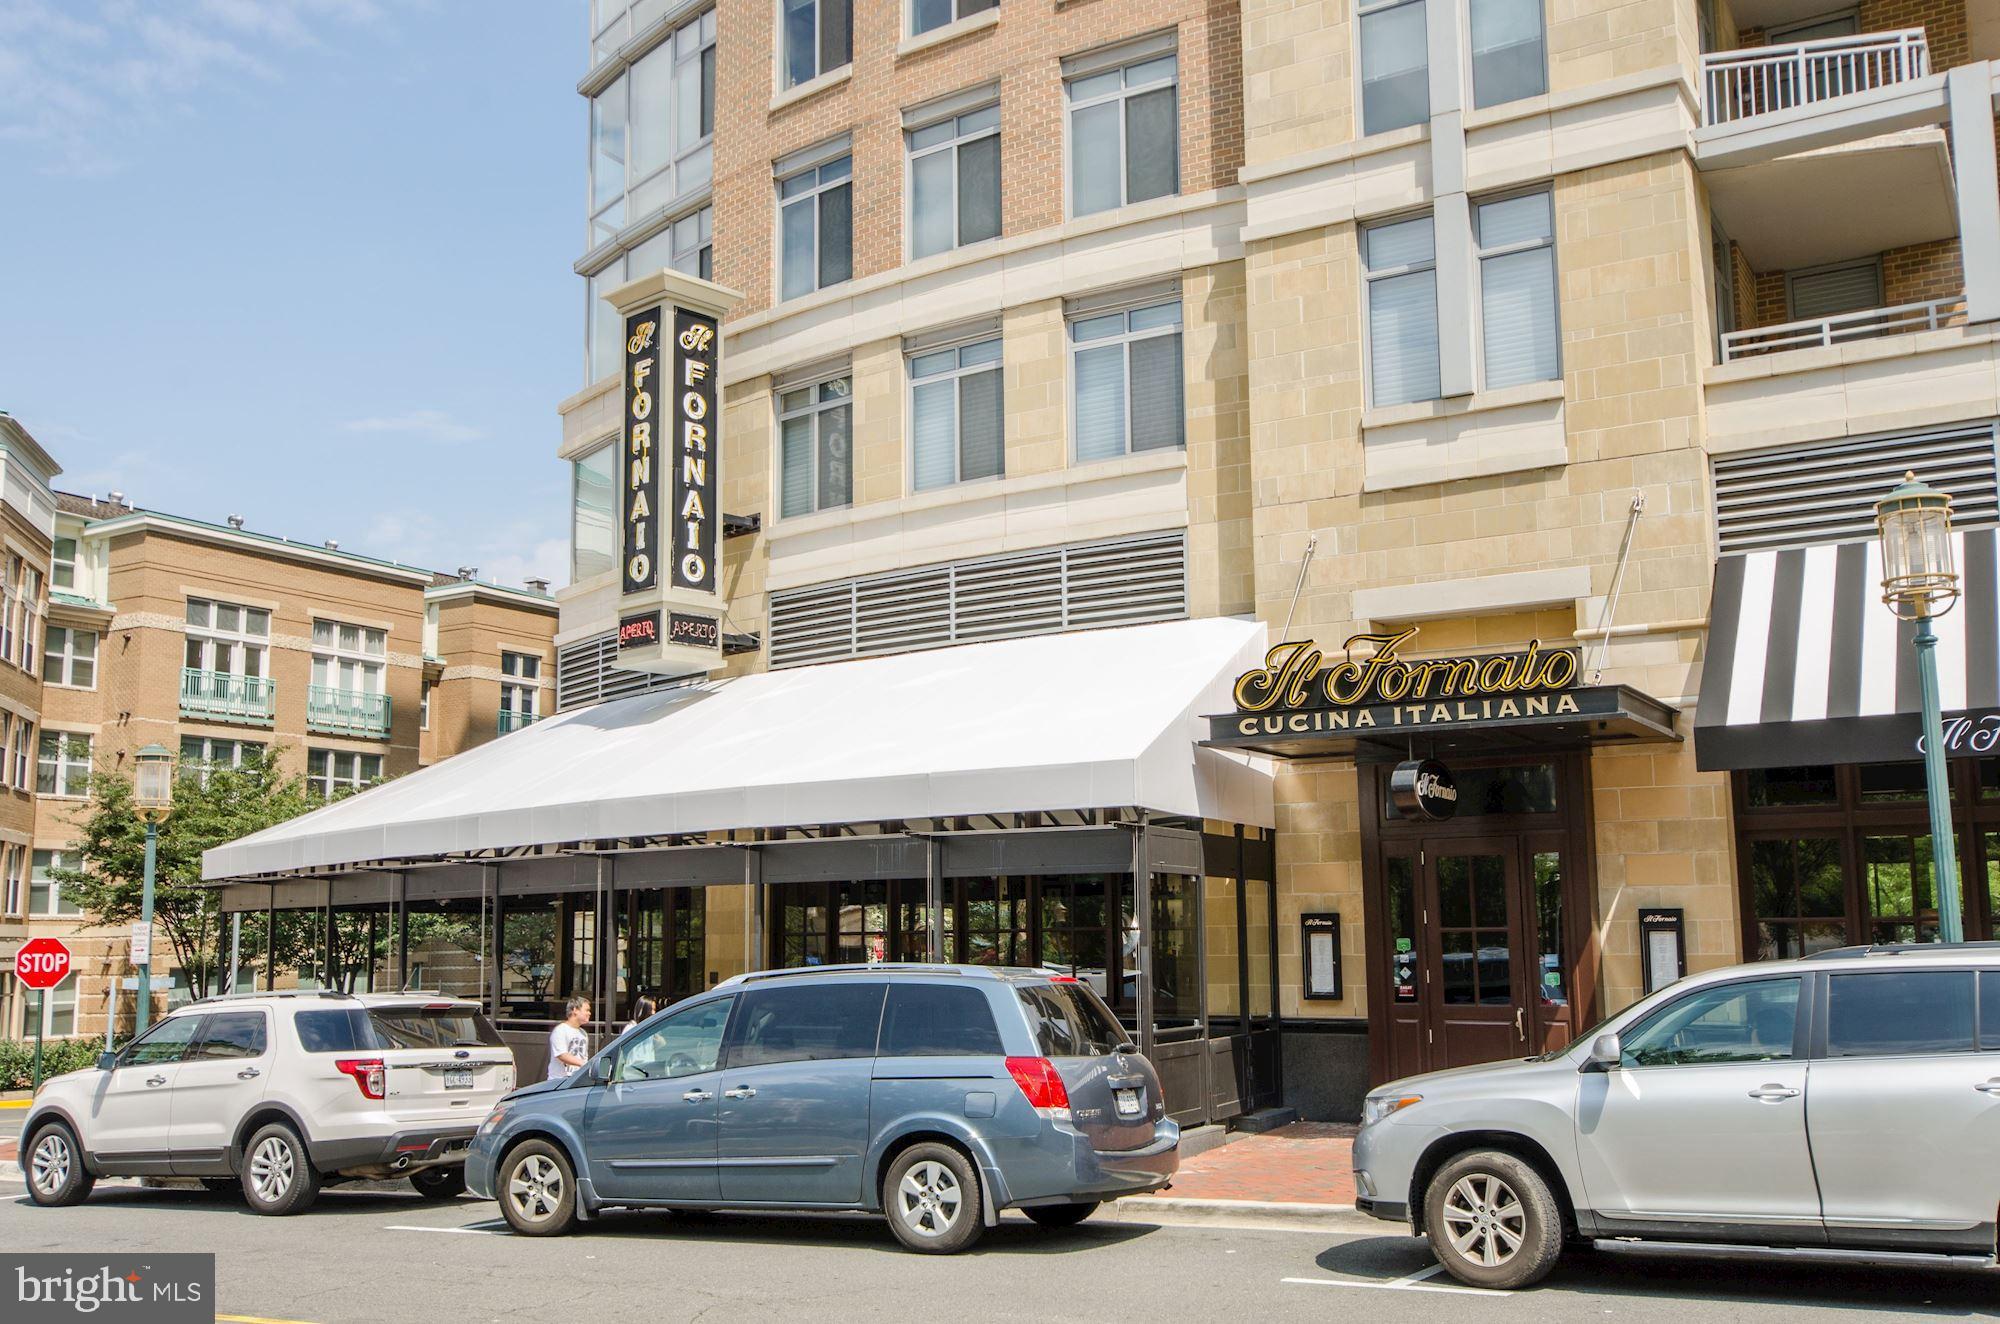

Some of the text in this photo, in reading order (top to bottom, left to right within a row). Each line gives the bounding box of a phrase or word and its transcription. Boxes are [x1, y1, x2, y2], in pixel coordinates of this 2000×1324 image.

[629, 358, 654, 583] FORNAIO
[681, 358, 709, 583] FORNAIO
[620, 620, 655, 641] APERTO
[671, 621, 717, 640] APERTO
[1233, 627, 1577, 711] Il Fornaio
[1238, 694, 1580, 736] CUCINA ITALIANA
[1428, 774, 1457, 801] Fornaio
[19, 952, 68, 973] STOP
